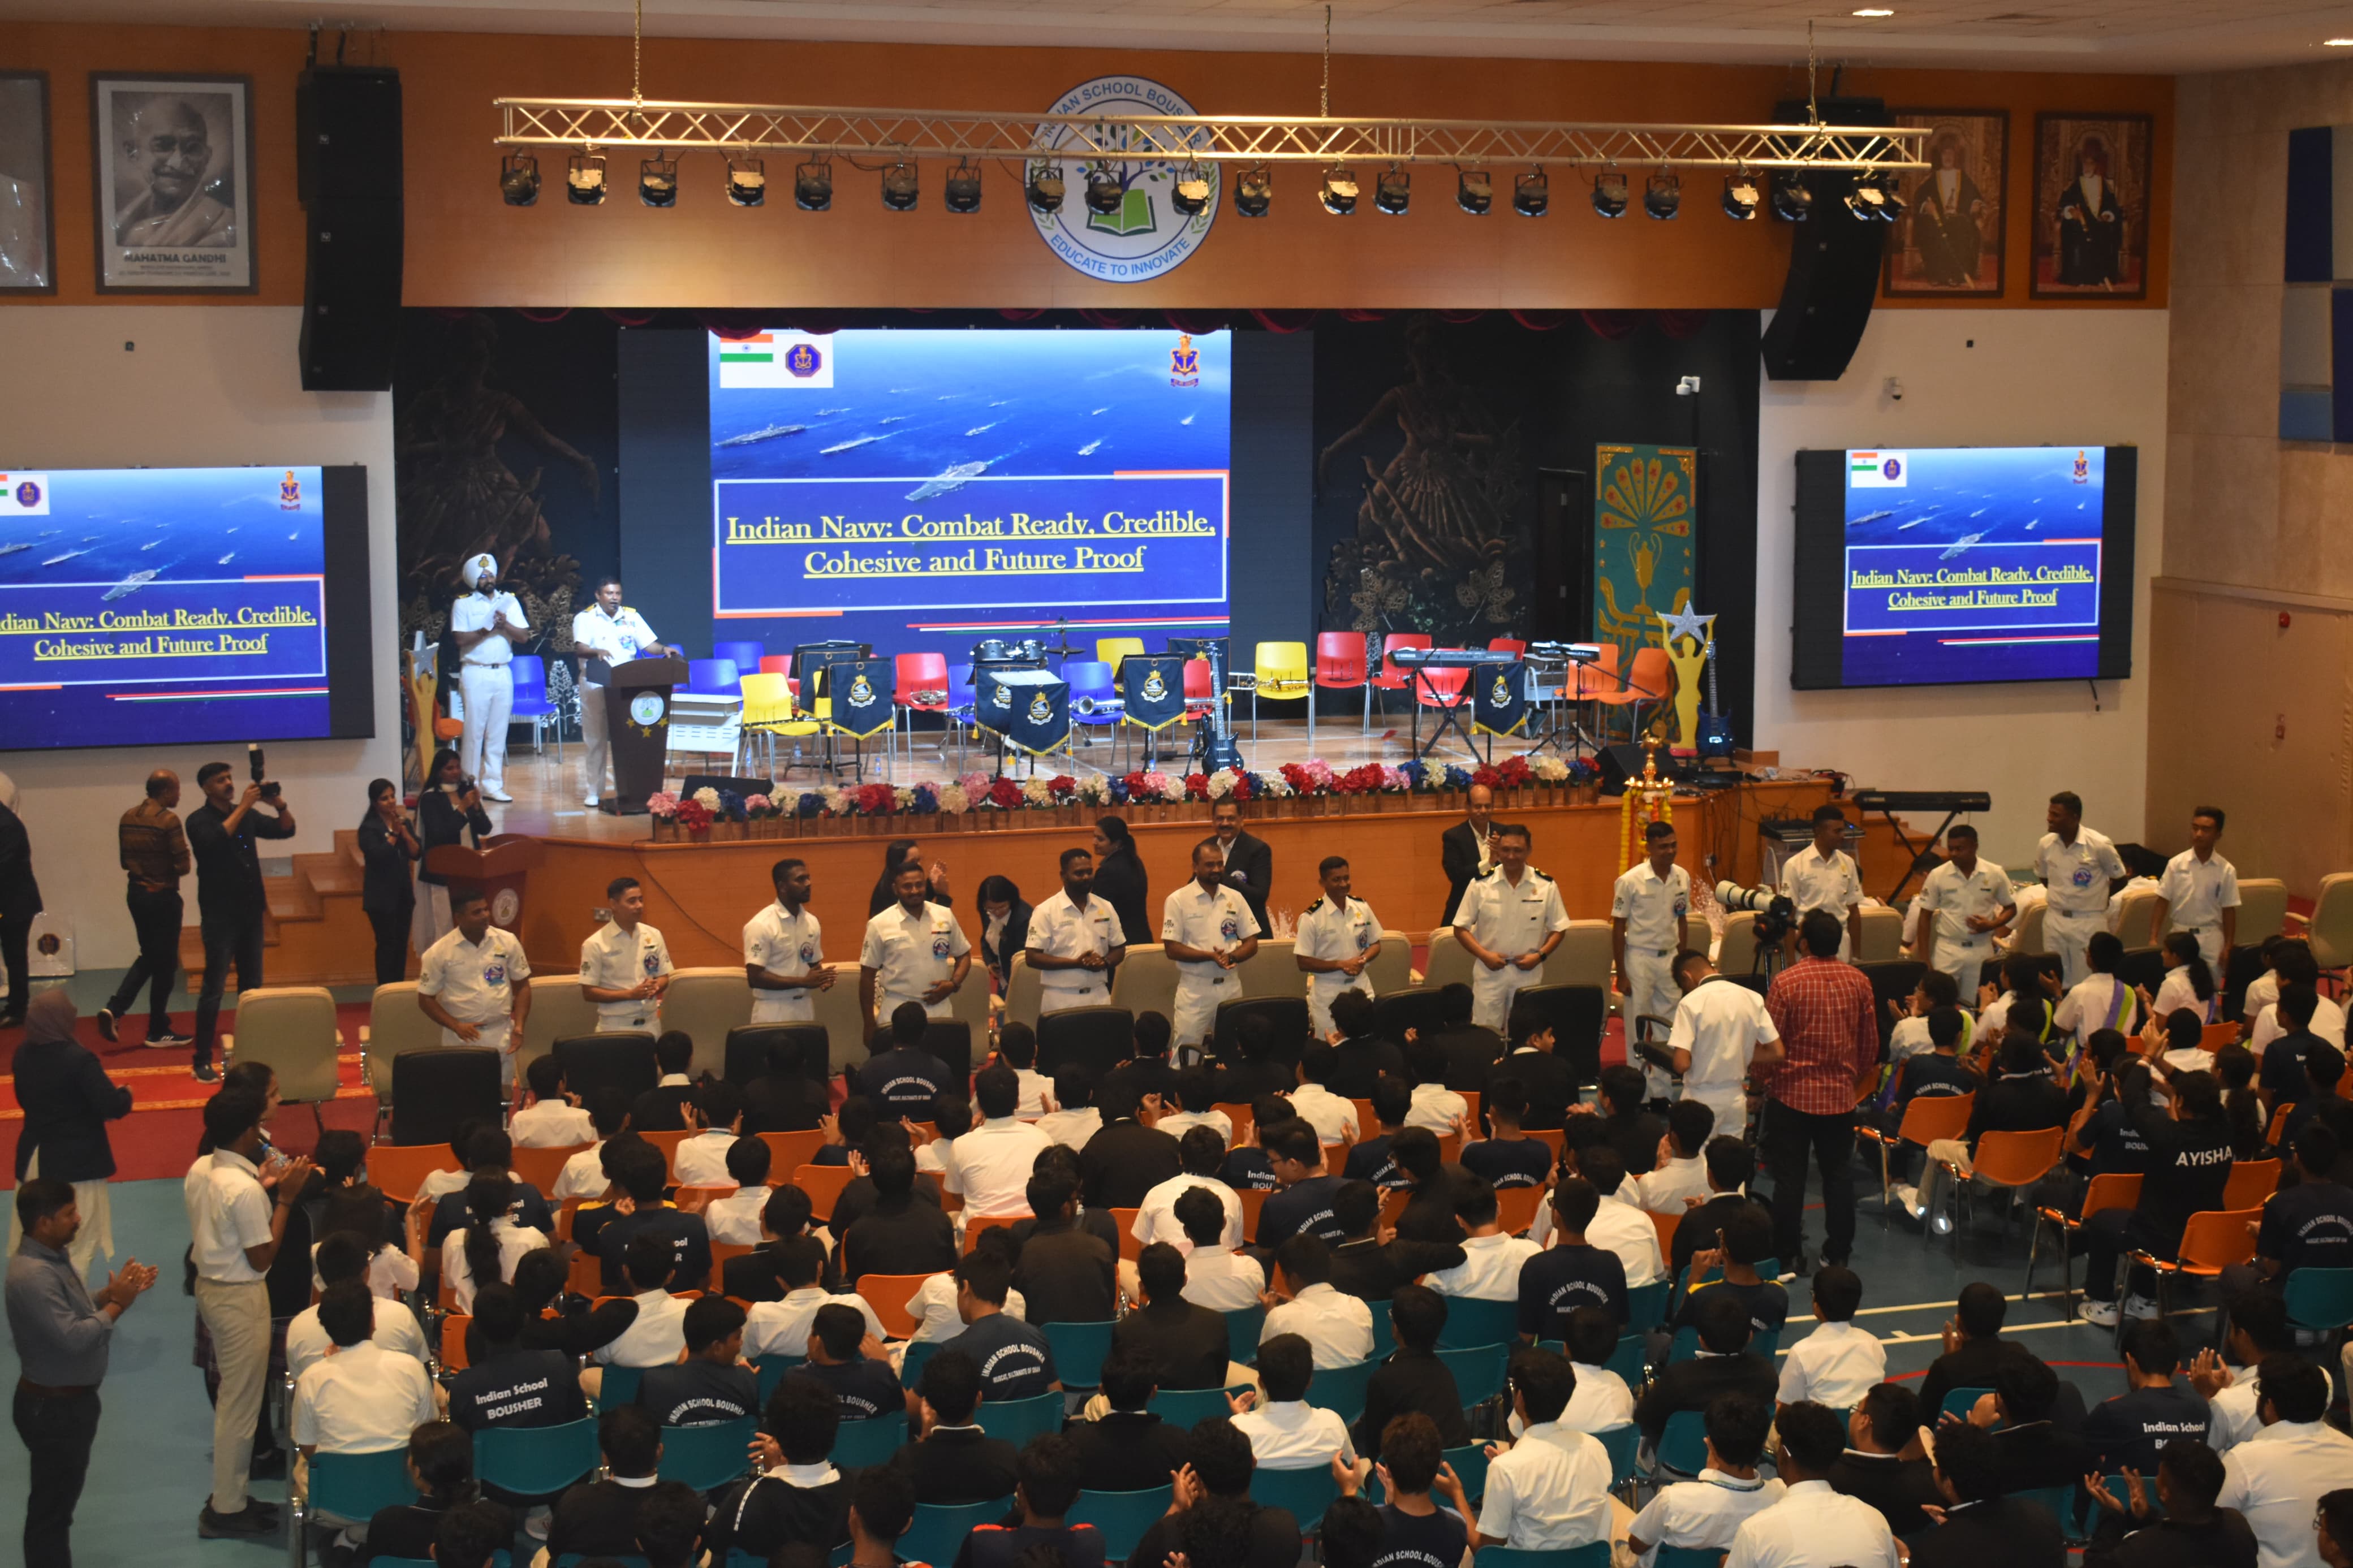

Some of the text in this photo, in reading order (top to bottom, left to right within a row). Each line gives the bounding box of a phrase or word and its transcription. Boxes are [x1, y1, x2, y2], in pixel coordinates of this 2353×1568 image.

[1083, 82, 1141, 101] SCHOOL
[1147, 88, 1202, 145] BOUSER
[124, 253, 226, 263] MAHATMA GANDHI
[1050, 234, 1190, 276] EDUCATE TO INNOVATE
[727, 511, 1216, 540] Indian Navy: Combat Ready, Credible,
[804, 546, 1147, 574] Cohesive and Future Proof
[1852, 570, 1893, 585] Indian
[1897, 569, 1933, 584] Navy:
[1937, 567, 1988, 582] Combat
[1888, 588, 2059, 607] Cohesive and Future Proof
[0, 613, 40, 630] dian
[44, 612, 94, 629] Navy:
[100, 610, 170, 628] Combat
[34, 633, 269, 656] Cohesive and Future Proof
[2176, 1146, 2233, 1166] AYISHA
[1248, 1170, 1275, 1181] Indian
[1504, 1173, 1523, 1181] SCHOOL
[1313, 1210, 1334, 1222] SCHOOL
[1549, 1281, 1608, 1306] INDIAN SCHOOL BOUSHER
[981, 1344, 1045, 1377] INDIAN SCHOOL BOUSHER
[475, 1377, 548, 1405] Indian School
[487, 1397, 542, 1419] BOUSHER
[669, 1402, 689, 1423] INDIAN
[688, 1398, 714, 1409] SCHOOL
[846, 1396, 877, 1414] BOUSHER
[2143, 1421, 2205, 1433] Indian School
[1396, 1550, 1422, 1560] SCHOOL
